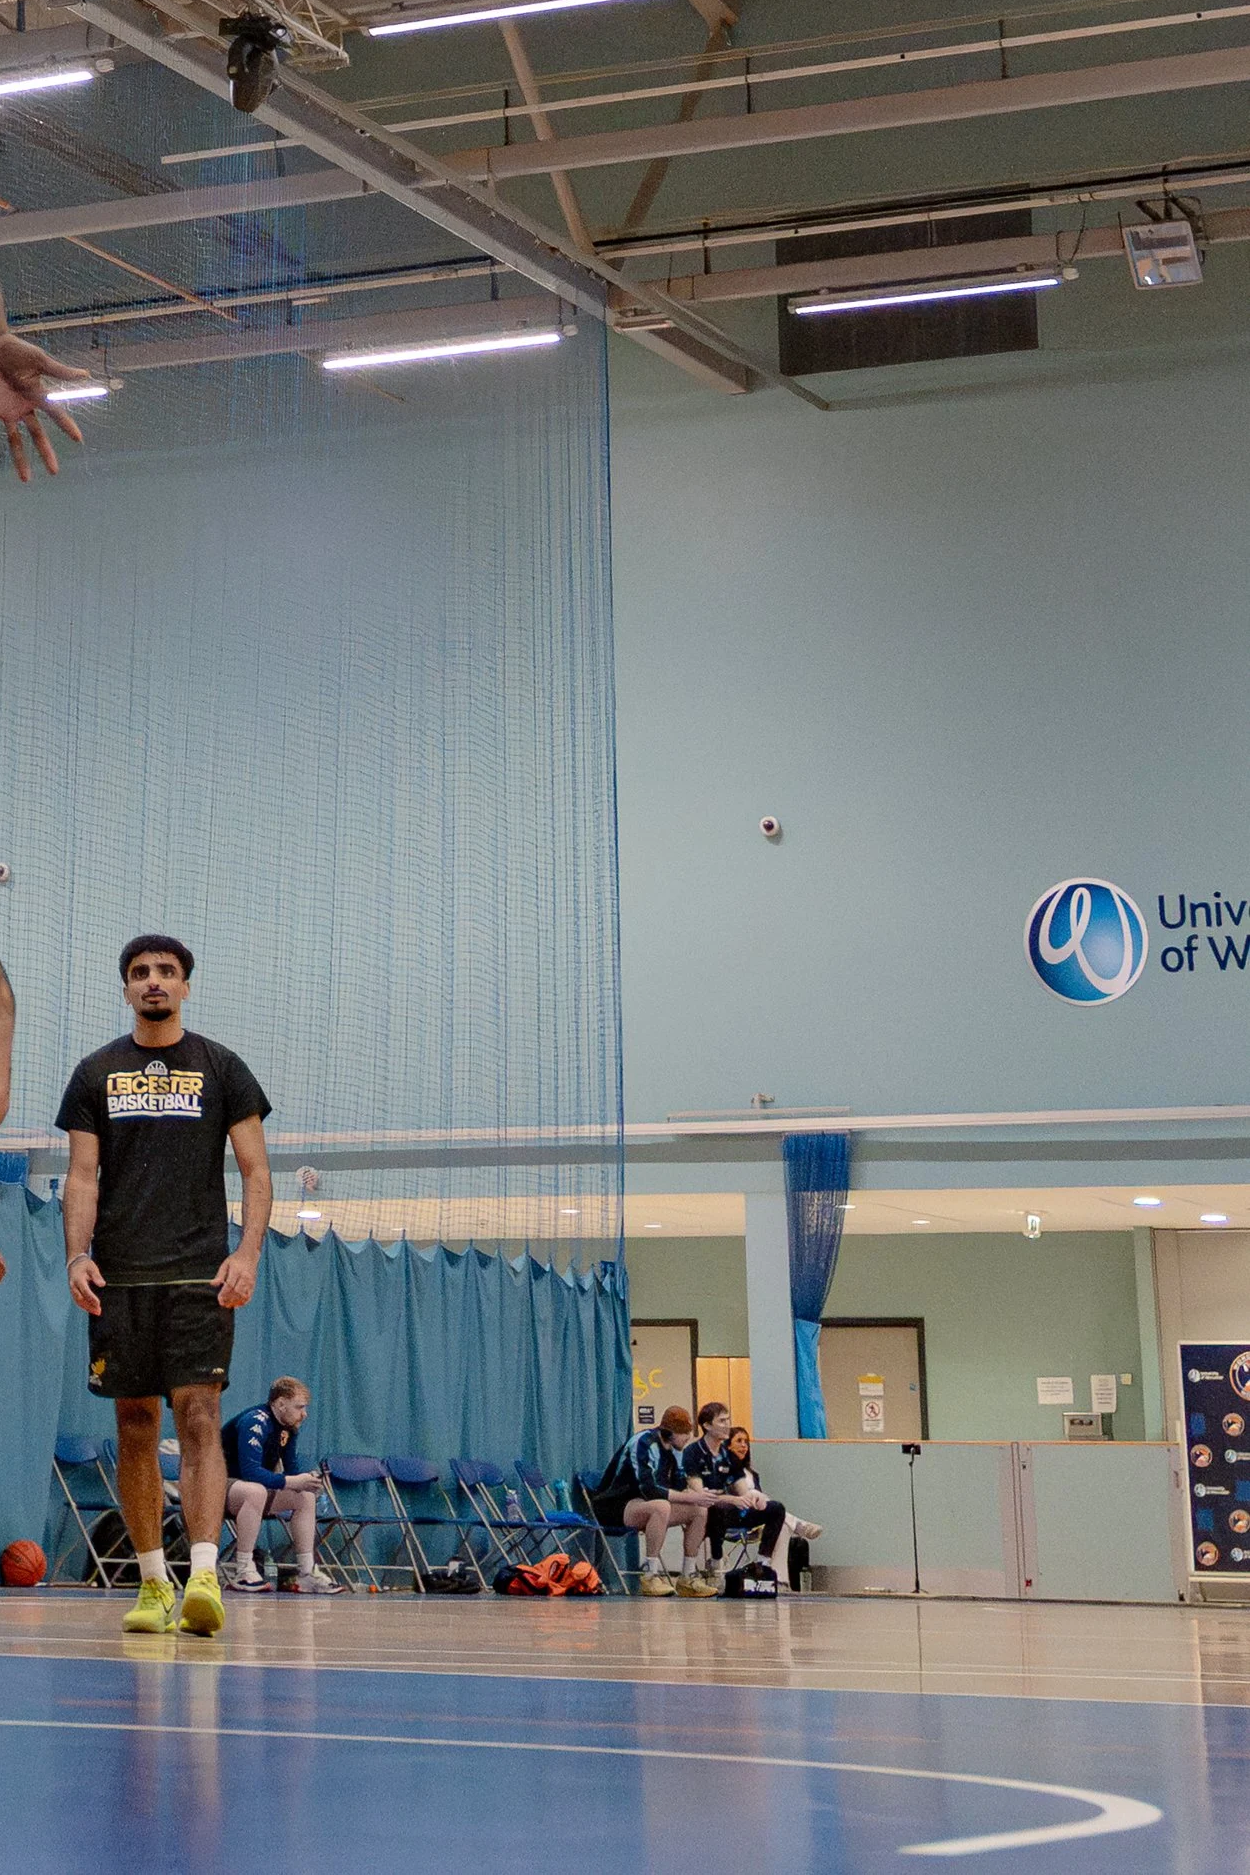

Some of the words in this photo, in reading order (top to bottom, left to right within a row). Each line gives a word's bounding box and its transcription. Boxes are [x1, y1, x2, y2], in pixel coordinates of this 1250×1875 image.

[1158, 892, 1250, 929] Univ
[1161, 934, 1198, 973] of
[107, 1075, 204, 1097] LEICESTER
[107, 1093, 202, 1113] BASKETBALL
